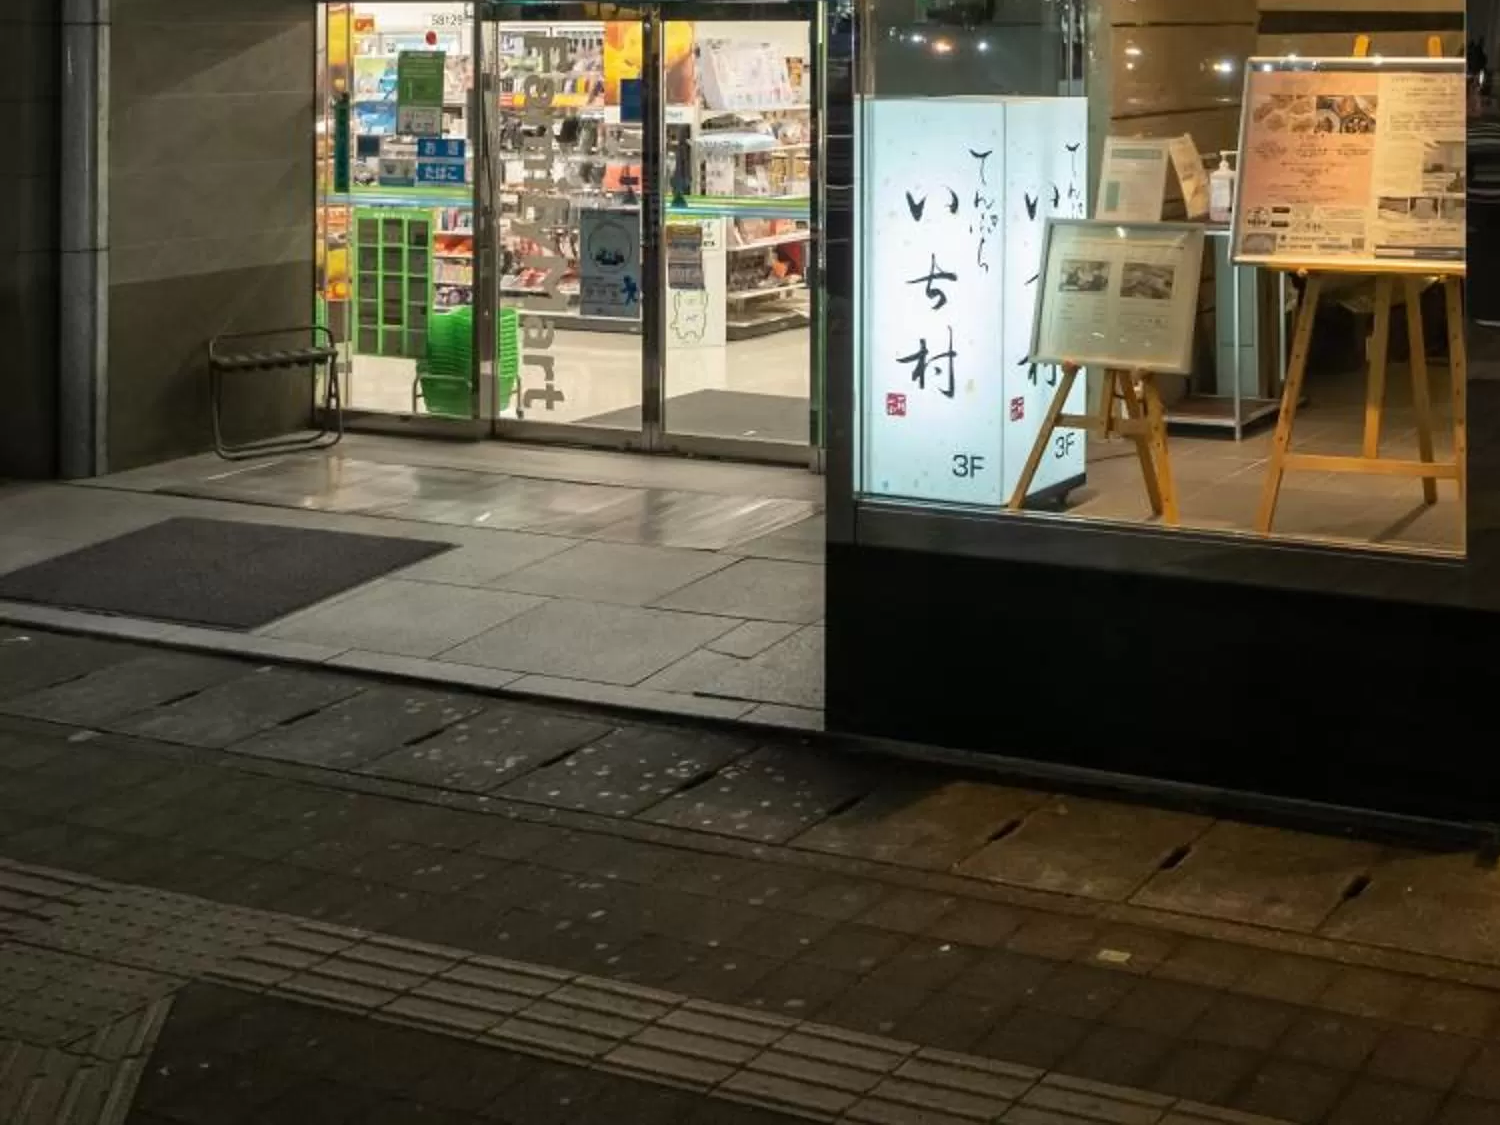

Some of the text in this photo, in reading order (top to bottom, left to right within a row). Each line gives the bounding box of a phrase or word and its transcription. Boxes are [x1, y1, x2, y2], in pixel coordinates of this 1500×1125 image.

[896, 186, 958, 398] いち村
[1054, 432, 1075, 460] 3F
[952, 454, 986, 479] 3F
